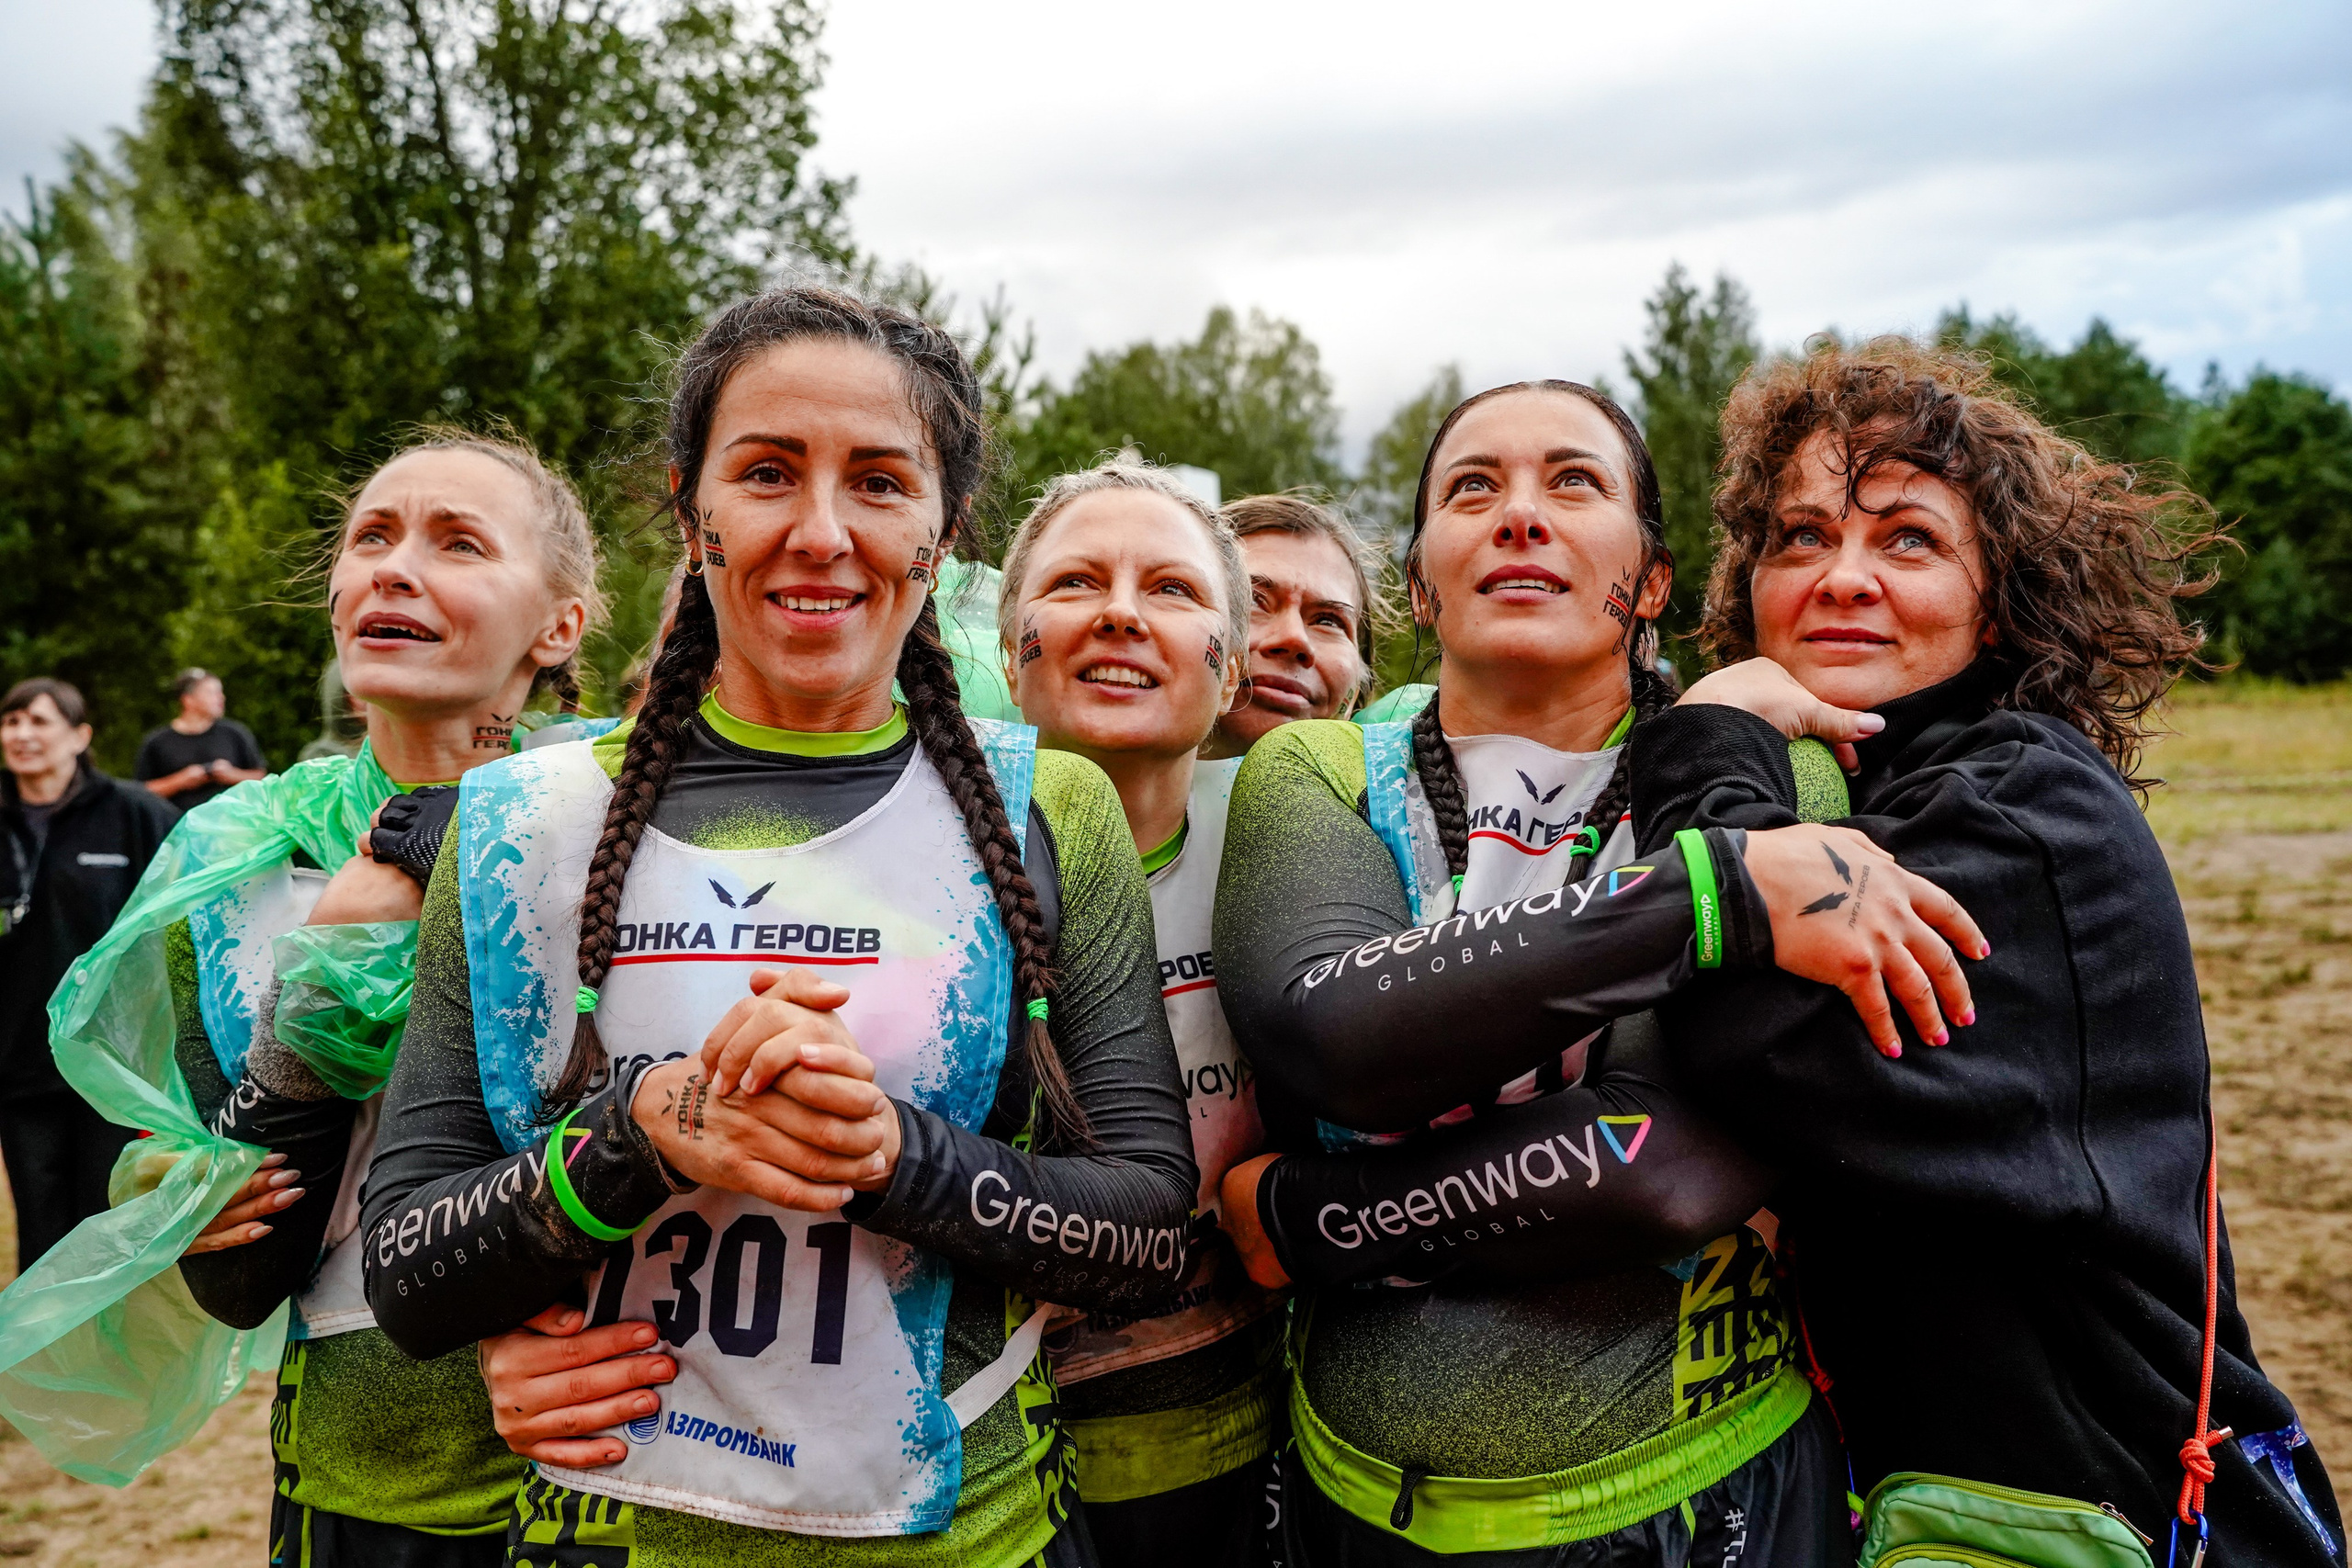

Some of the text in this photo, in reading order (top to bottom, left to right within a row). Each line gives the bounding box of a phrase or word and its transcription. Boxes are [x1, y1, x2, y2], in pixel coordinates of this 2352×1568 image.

[1468, 805, 1583, 846] НКА ГЕР
[1848, 864, 1871, 930] ЛИГА ГЕРОЕВ
[615, 921, 882, 953] ОНКА ГЕРОЕВ
[1303, 874, 1605, 989] Greenway
[1378, 931, 1529, 991] GLOBAL
[1701, 903, 1714, 962] Greenway
[1158, 951, 1215, 987] РОЕ
[677, 1074, 699, 1134] ГОНКА
[692, 1082, 709, 1141] ГЕРОЕ
[1317, 1123, 1601, 1250] Greenway
[970, 1169, 1189, 1281] Greenway
[1419, 1207, 1556, 1252] GLOBAL
[397, 1225, 507, 1296] GLOBAL
[664, 1410, 797, 1469] АЗПРОМБАНК
